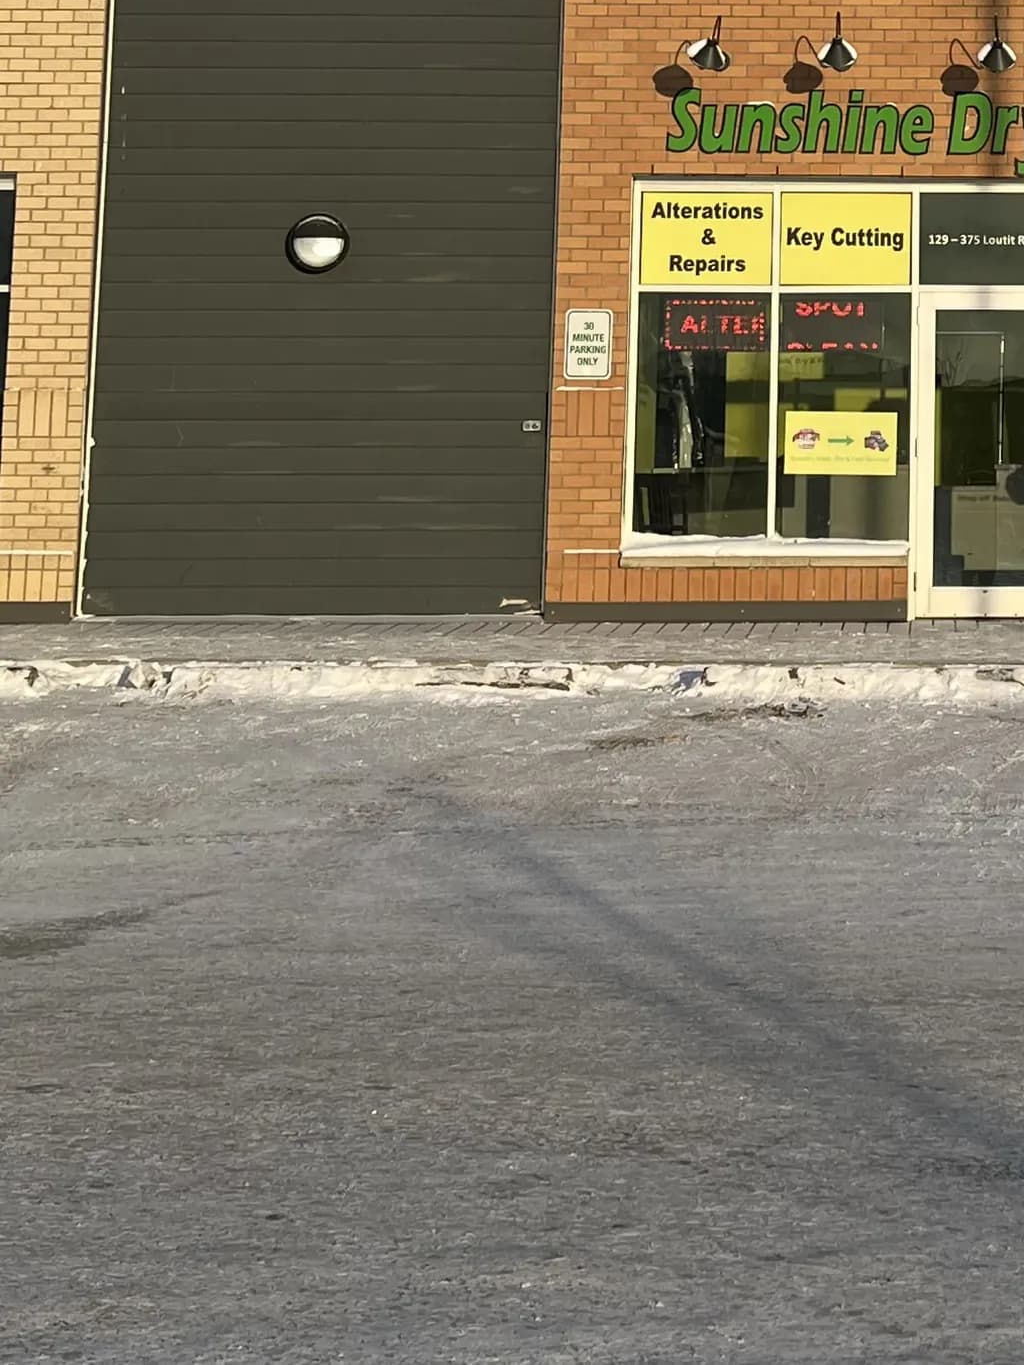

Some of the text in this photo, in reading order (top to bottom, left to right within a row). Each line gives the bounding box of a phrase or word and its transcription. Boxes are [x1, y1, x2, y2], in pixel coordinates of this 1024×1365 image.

[666, 87, 934, 155] Sunshine
[651, 202, 764, 219] Alterations
[701, 228, 716, 245] &
[786, 227, 904, 251] Key Cutting
[928, 234, 949, 245] 129
[960, 235, 980, 245] 375
[983, 234, 1015, 245] Loutit
[669, 255, 746, 275] Repairs
[584, 322, 594, 330] 30
[572, 334, 604, 342] MINUTE
[570, 345, 606, 354] PARKING
[577, 357, 598, 365] ONLY
